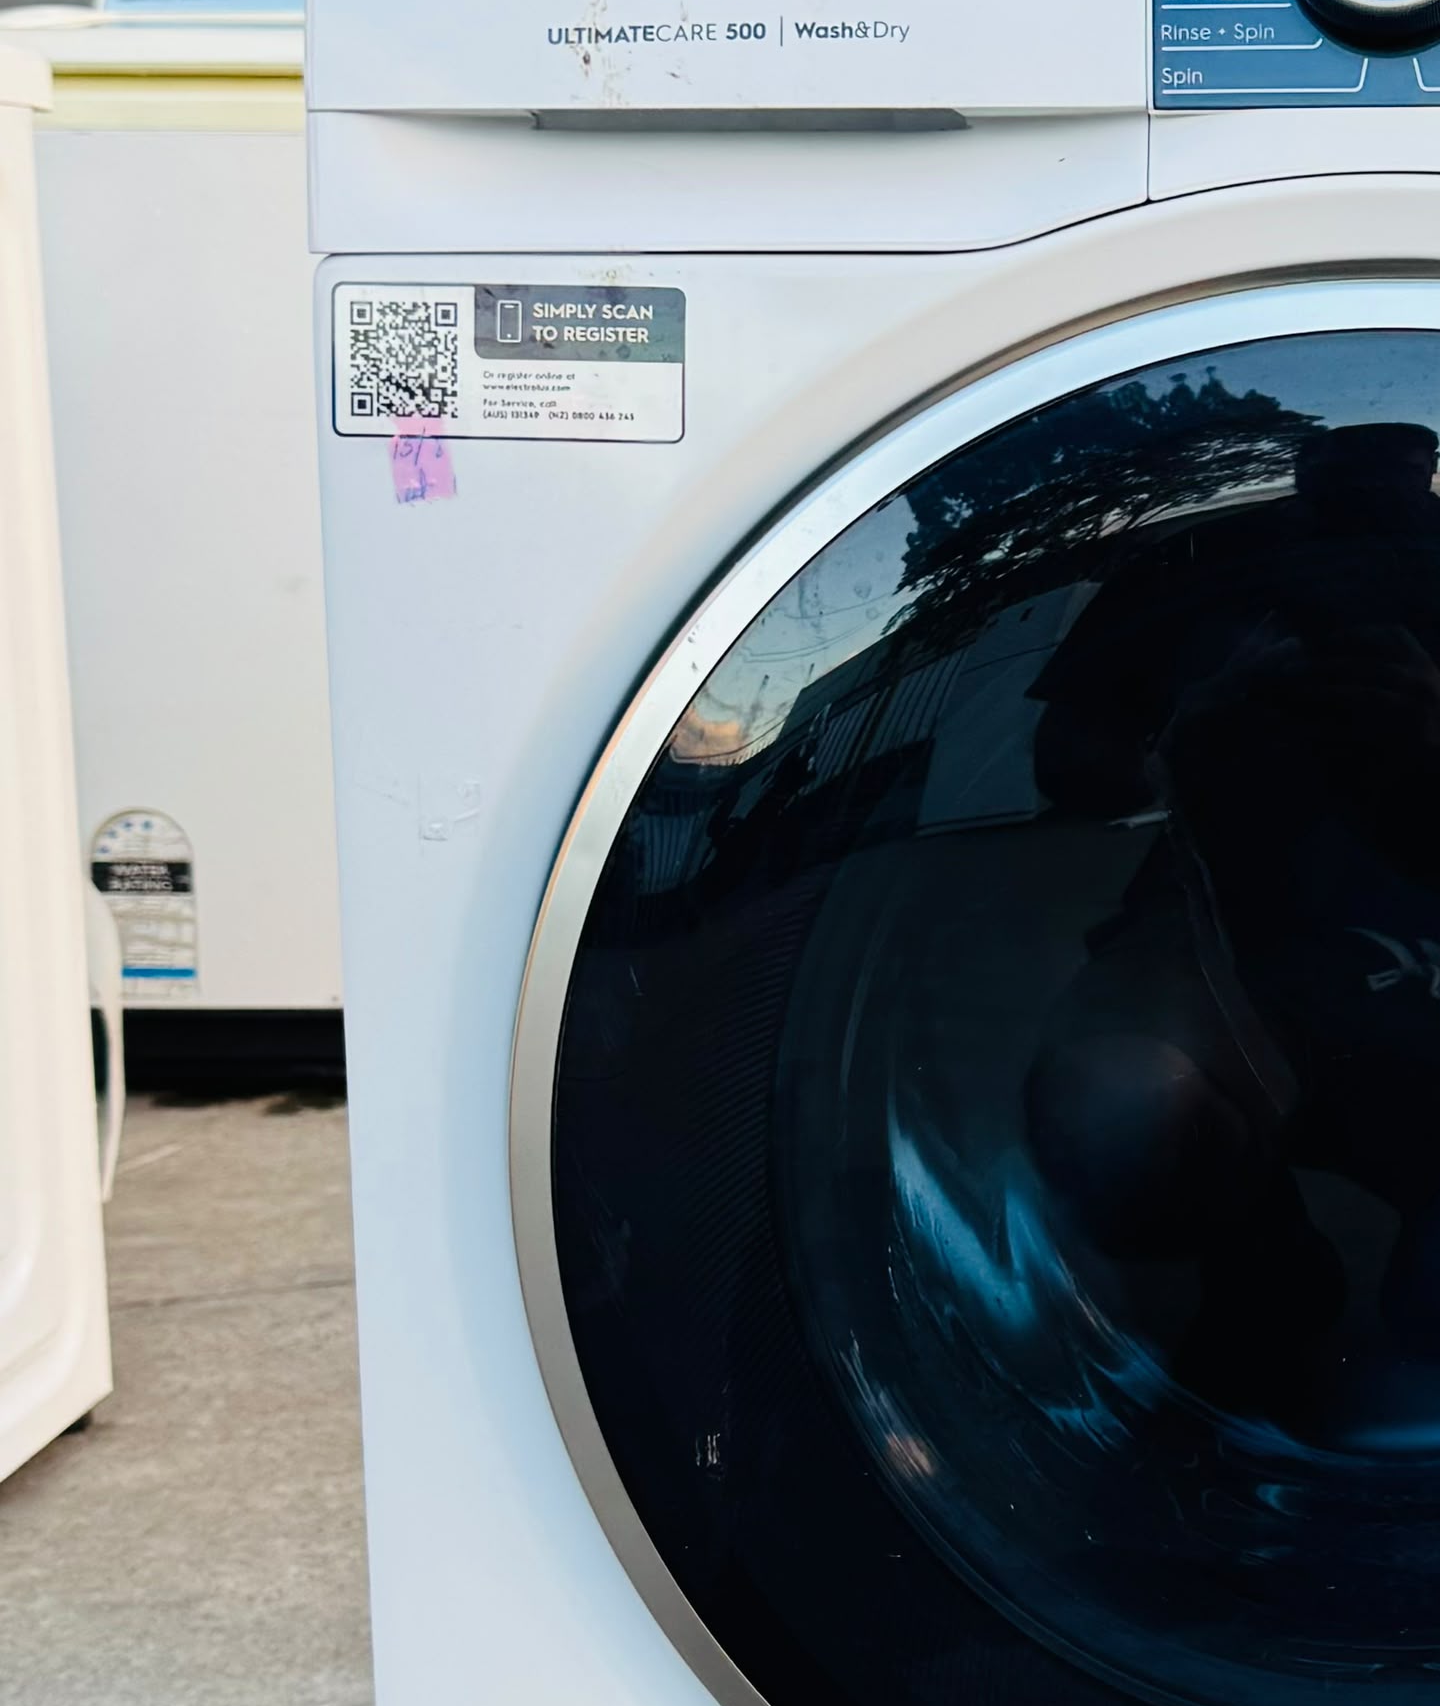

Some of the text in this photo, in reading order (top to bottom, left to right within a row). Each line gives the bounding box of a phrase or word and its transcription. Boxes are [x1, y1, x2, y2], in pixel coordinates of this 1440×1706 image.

[547, 23, 766, 45] ULTIMATECARE 500
[794, 21, 910, 43] Wash&Dry
[1161, 23, 1275, 44] Rinse Spin
[1161, 67, 1203, 87] Spin
[532, 303, 653, 321] SIMPLY SCAN
[532, 325, 649, 344] TO REGISTER
